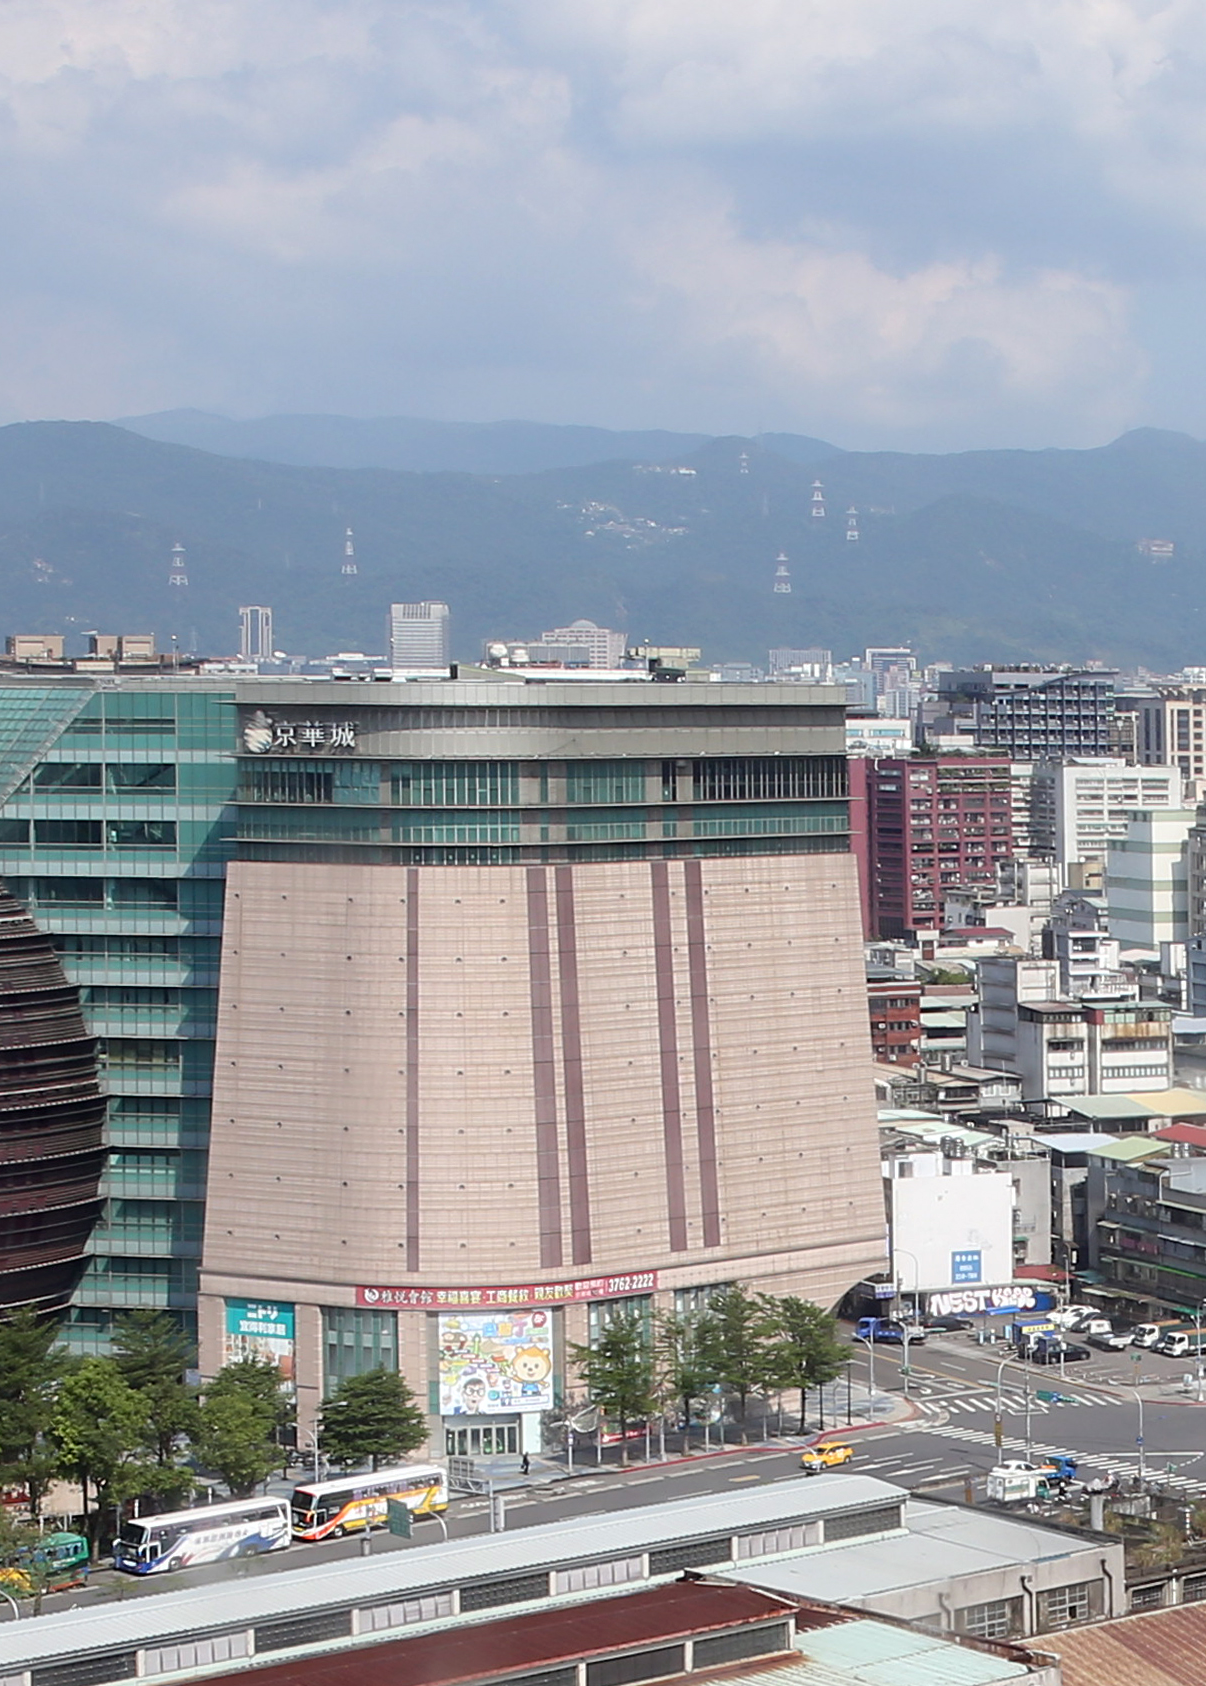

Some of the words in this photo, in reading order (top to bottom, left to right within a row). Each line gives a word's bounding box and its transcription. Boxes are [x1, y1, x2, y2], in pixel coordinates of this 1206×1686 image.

[275, 720, 356, 748] 京華城
[608, 1273, 654, 1293] 3762-2222
[930, 1289, 991, 1317] NEST
